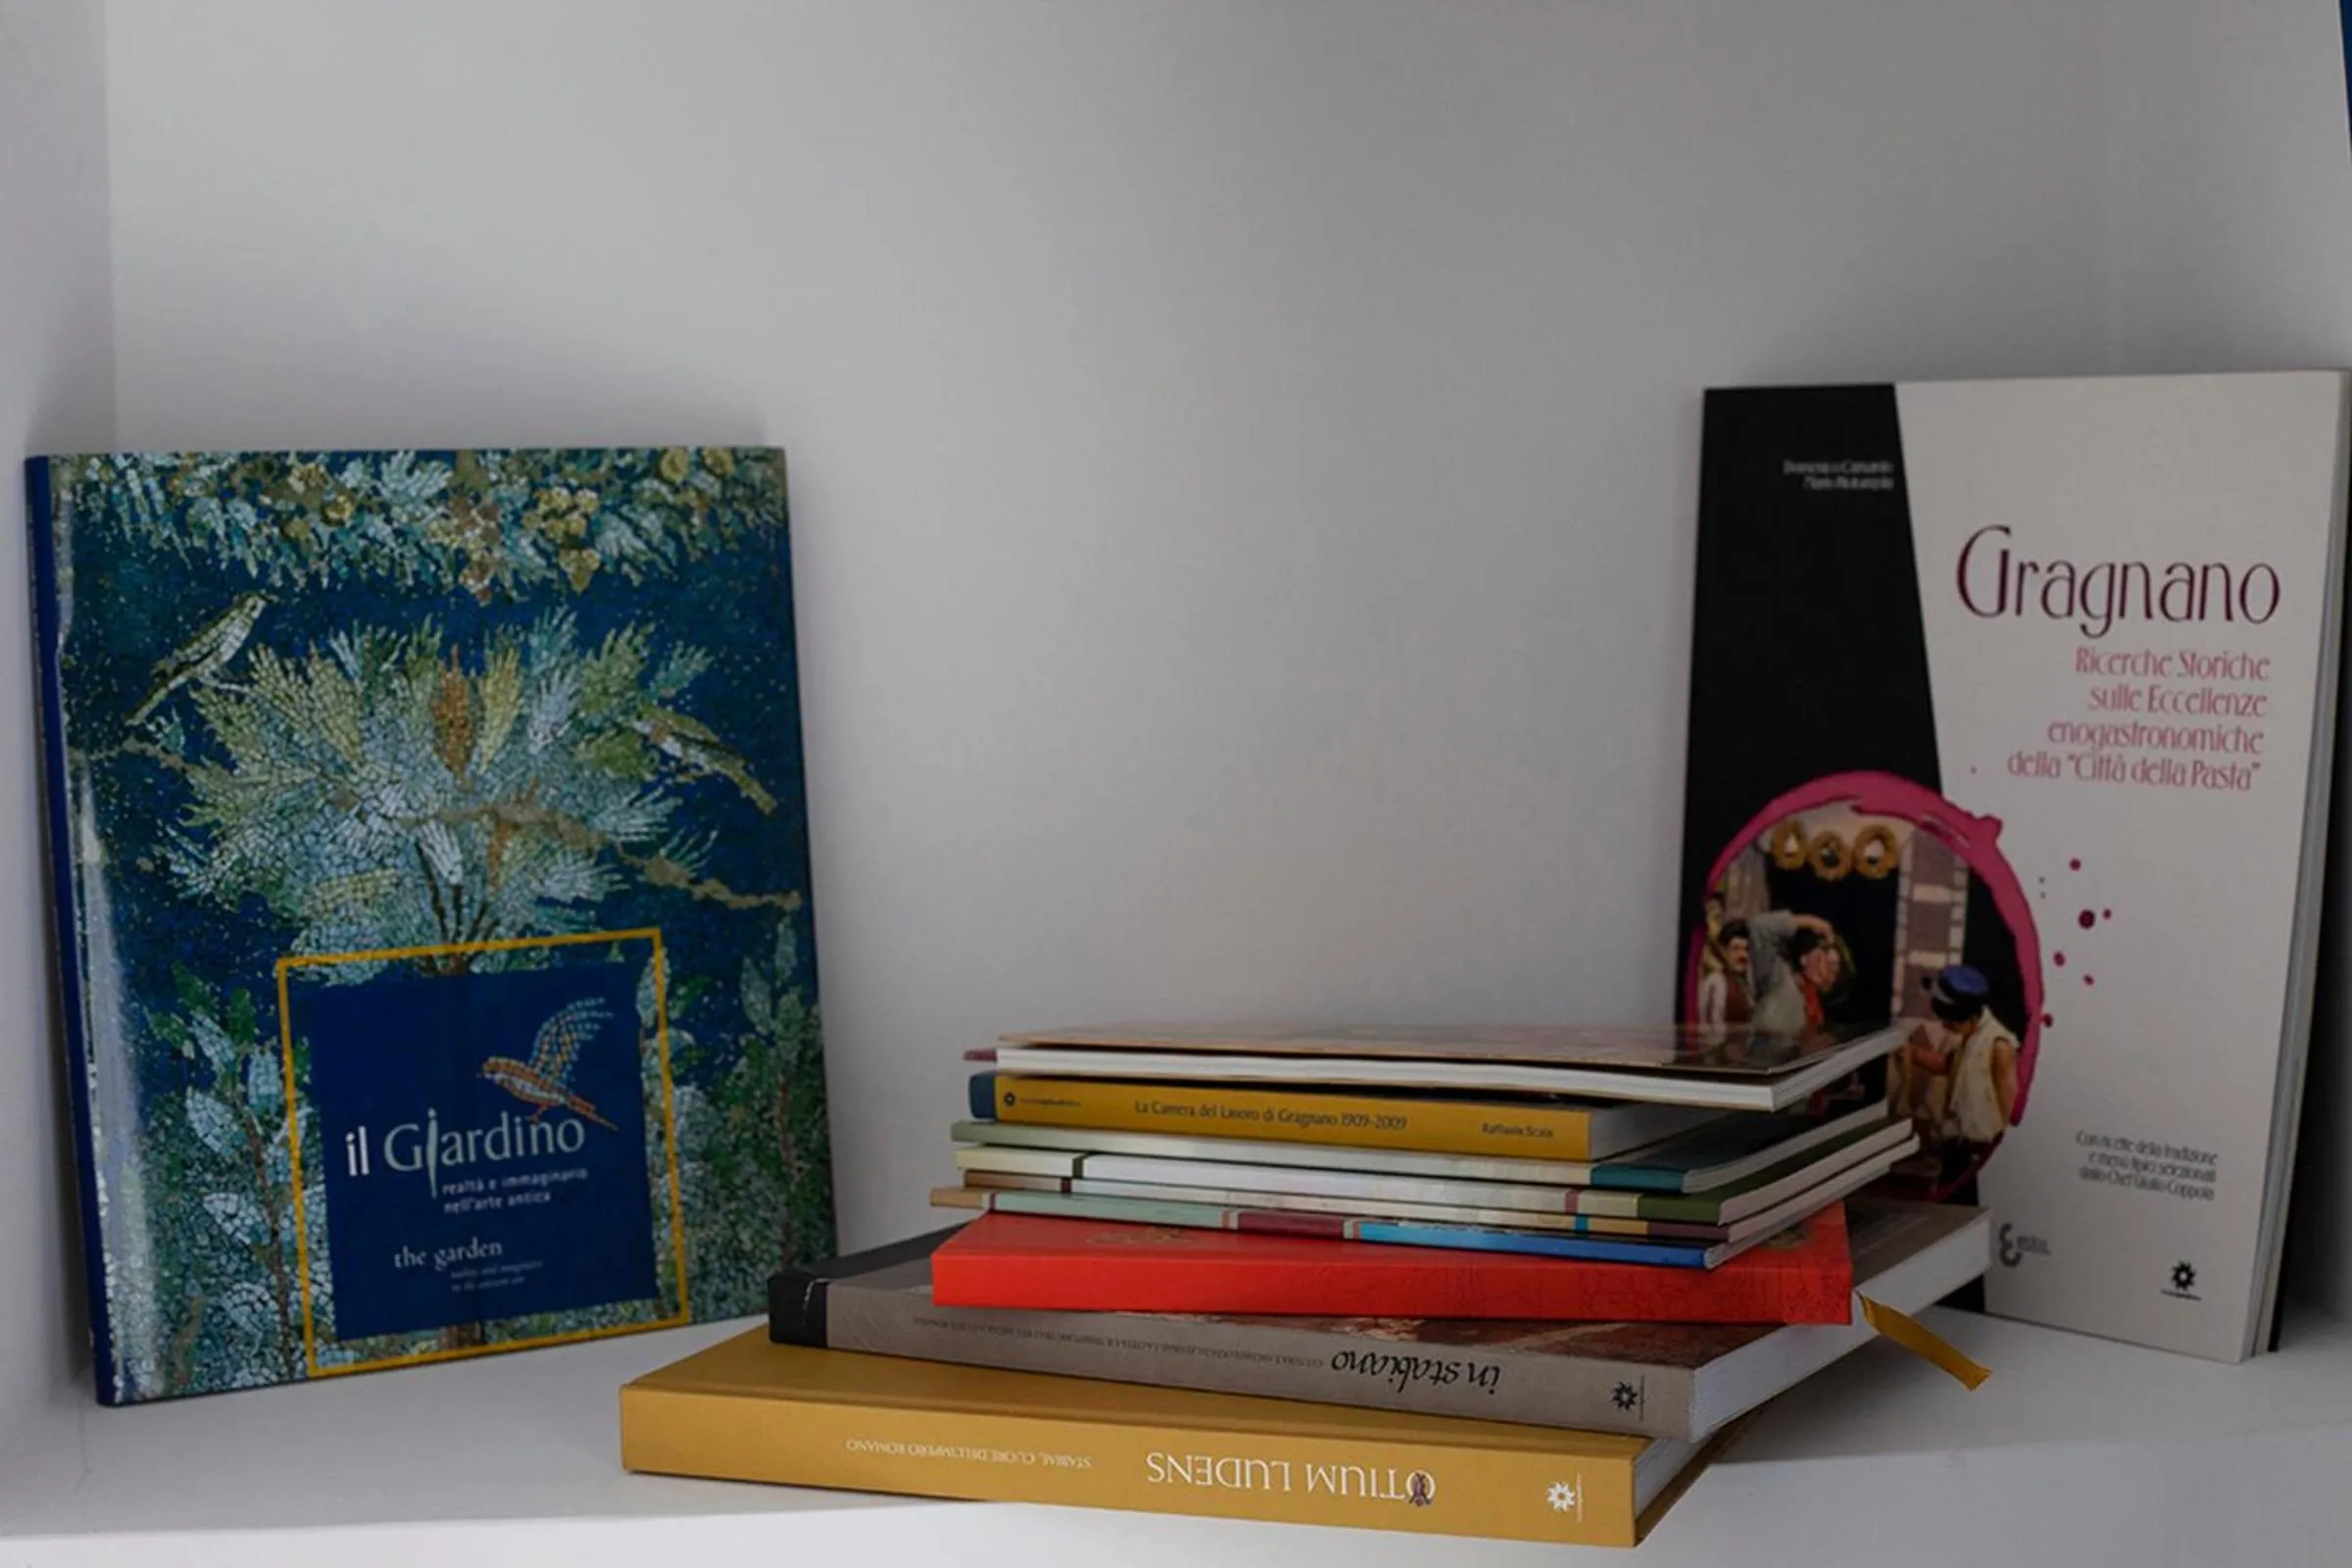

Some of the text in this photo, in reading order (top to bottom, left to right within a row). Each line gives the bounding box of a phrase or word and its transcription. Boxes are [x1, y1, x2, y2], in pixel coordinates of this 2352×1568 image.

[1956, 524, 2280, 639] Gragnano
[2075, 647, 2271, 681] Ricerche Storiche
[2088, 683, 2268, 717] sulle Eccellenze
[2047, 720, 2264, 755] enogastronomiche
[2007, 751, 2061, 778] della
[2131, 757, 2186, 788] della
[1135, 1100, 1407, 1131] La Camera del Lavoro di Gragnano 1909-2009
[345, 1107, 586, 1199] il Giardino
[442, 1168, 588, 1196] realtà e immaginario
[508, 1191, 551, 1207] antica
[394, 1246, 426, 1268] the
[434, 1237, 503, 1271] garden
[1331, 1348, 1501, 1396] in stabiano
[845, 1439, 906, 1456] ROMANO
[1146, 1451, 1437, 1507] OTIUM LUDENS
